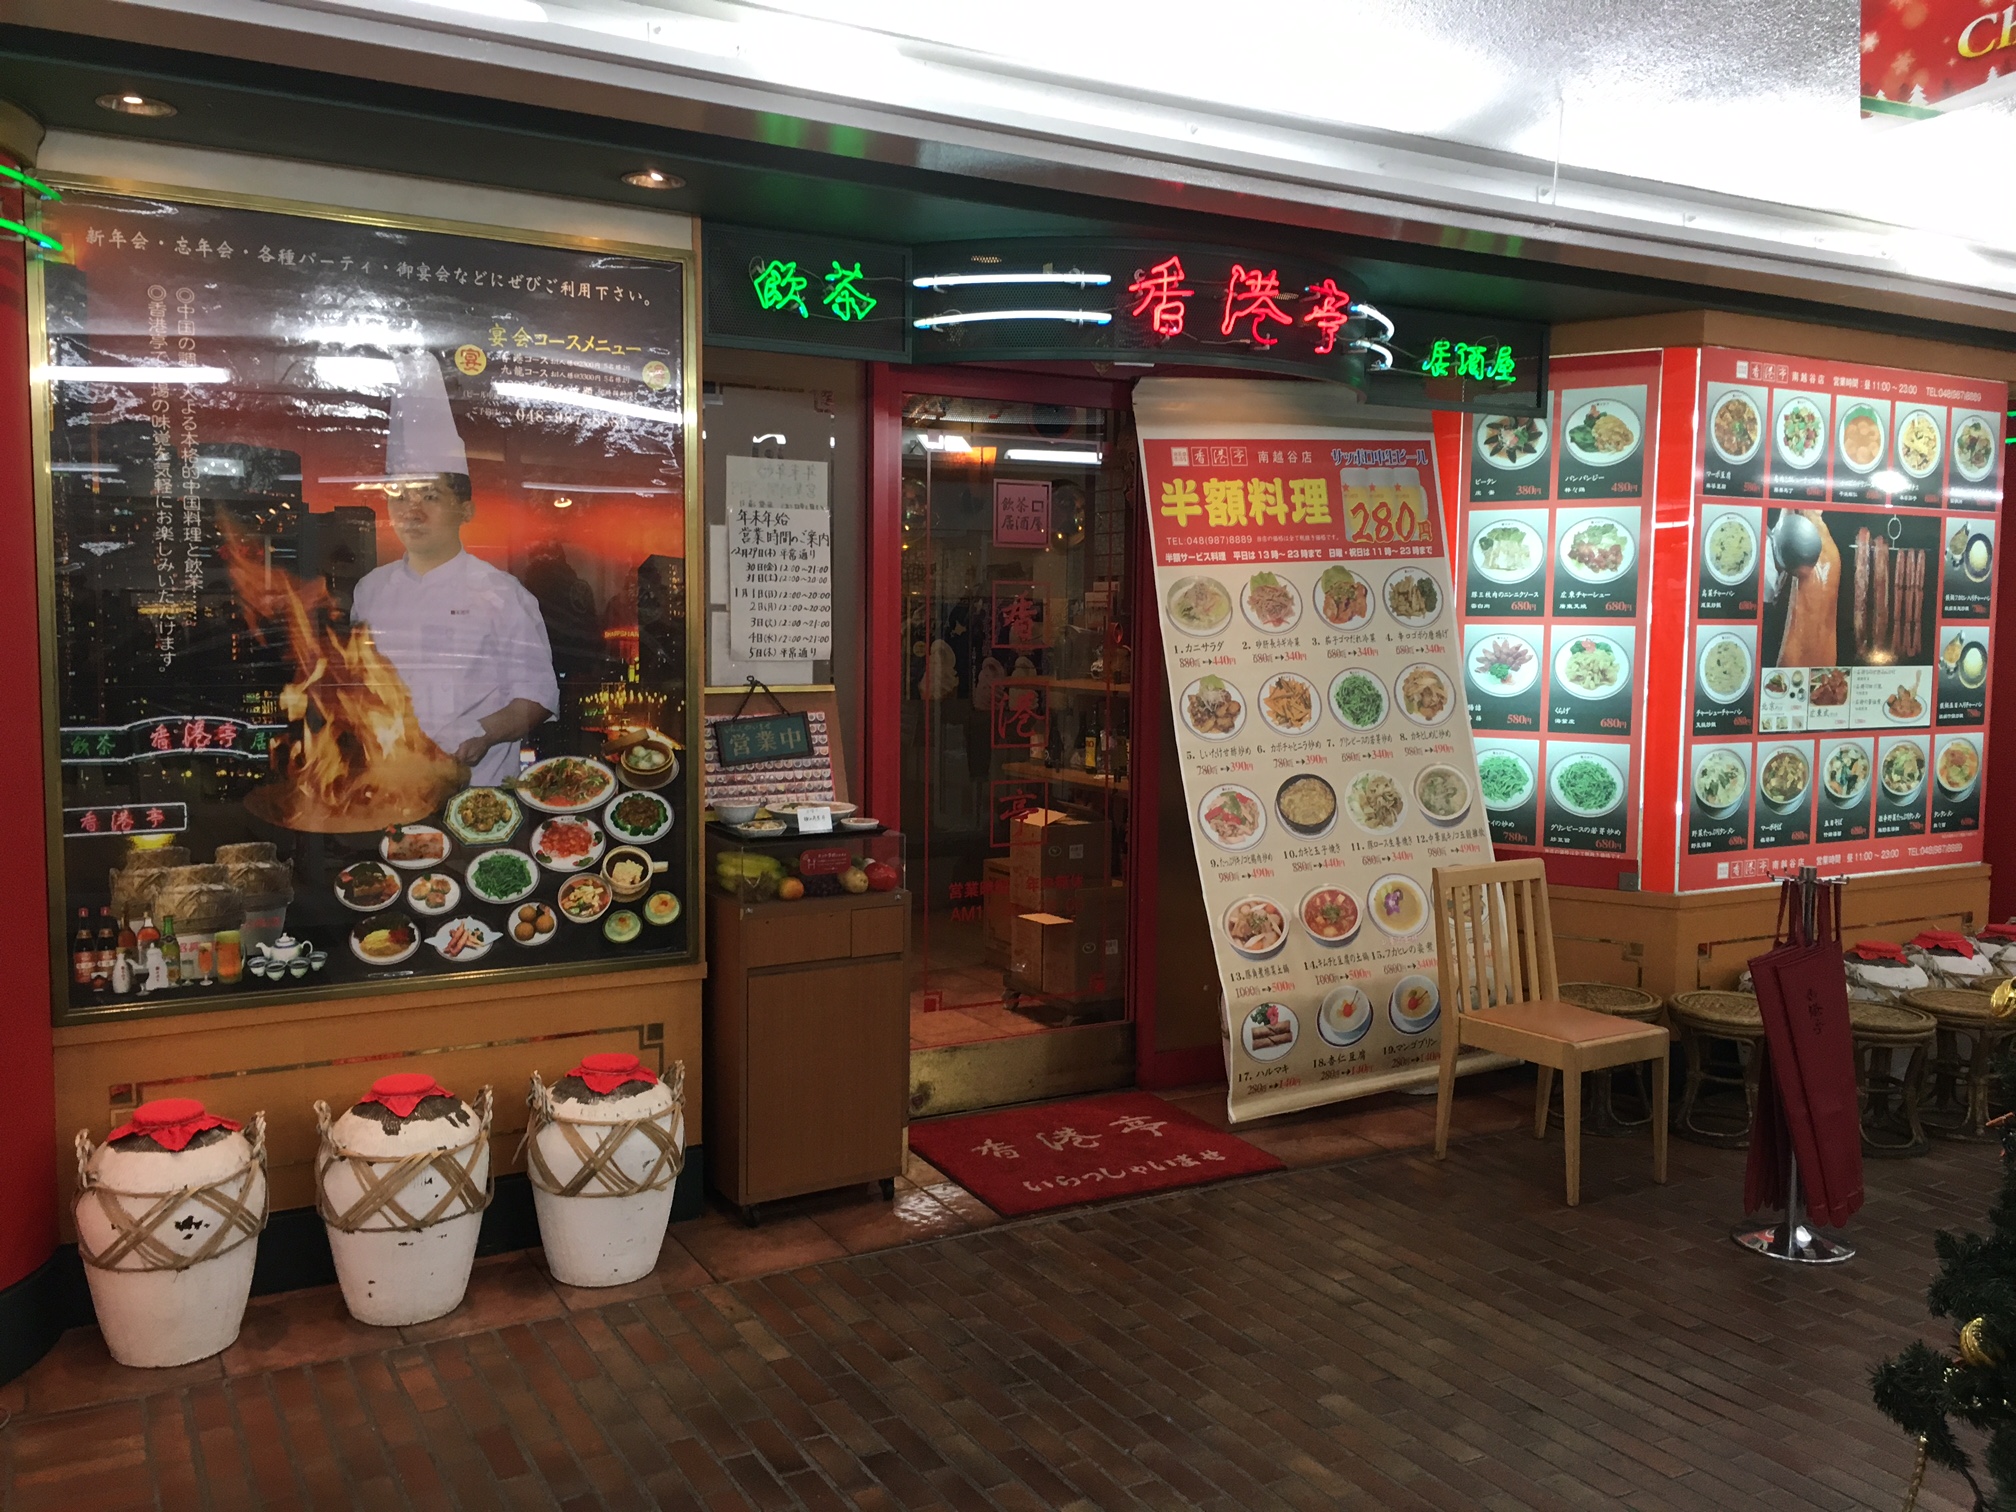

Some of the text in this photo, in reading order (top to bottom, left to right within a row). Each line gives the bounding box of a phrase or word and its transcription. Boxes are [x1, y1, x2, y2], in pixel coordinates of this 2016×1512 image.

[753, 260, 876, 320] 飲茶
[1128, 256, 1350, 354] 香港亭
[488, 323, 642, 356] 宴会コースメニュー
[1422, 340, 1517, 382] 居酒屋
[500, 364, 549, 378] 九龍コース
[1195, 449, 1245, 464] 香港亭
[1258, 450, 1313, 464] 南越谷店
[1516, 484, 1542, 496] 380円
[1610, 481, 1638, 493] 480円
[1160, 477, 1333, 528] 半額料理
[736, 508, 791, 528] 年末年始
[1001, 515, 1044, 532] 居酒屋
[1350, 501, 1433, 544] 280円
[738, 527, 831, 548] 営業時間のご案内
[1166, 535, 1253, 546] TEL:048(987)8889
[1165, 550, 1227, 563] 半額サービス料理
[1511, 601, 1537, 611] 680円
[1605, 601, 1633, 612] 680円
[1506, 714, 1532, 725] 580円
[1600, 718, 1627, 729] 680円
[150, 720, 238, 750] 香港亭
[728, 727, 802, 757] 営業中
[79, 807, 166, 832] 香港亭
[1503, 831, 1528, 843] 780円
[1595, 839, 1622, 850] 680円
[1255, 1065, 1290, 1078] ハルマキ
[971, 1115, 1168, 1159] 香港亭
[1022, 1149, 1227, 1192] いらっしゃいませ
